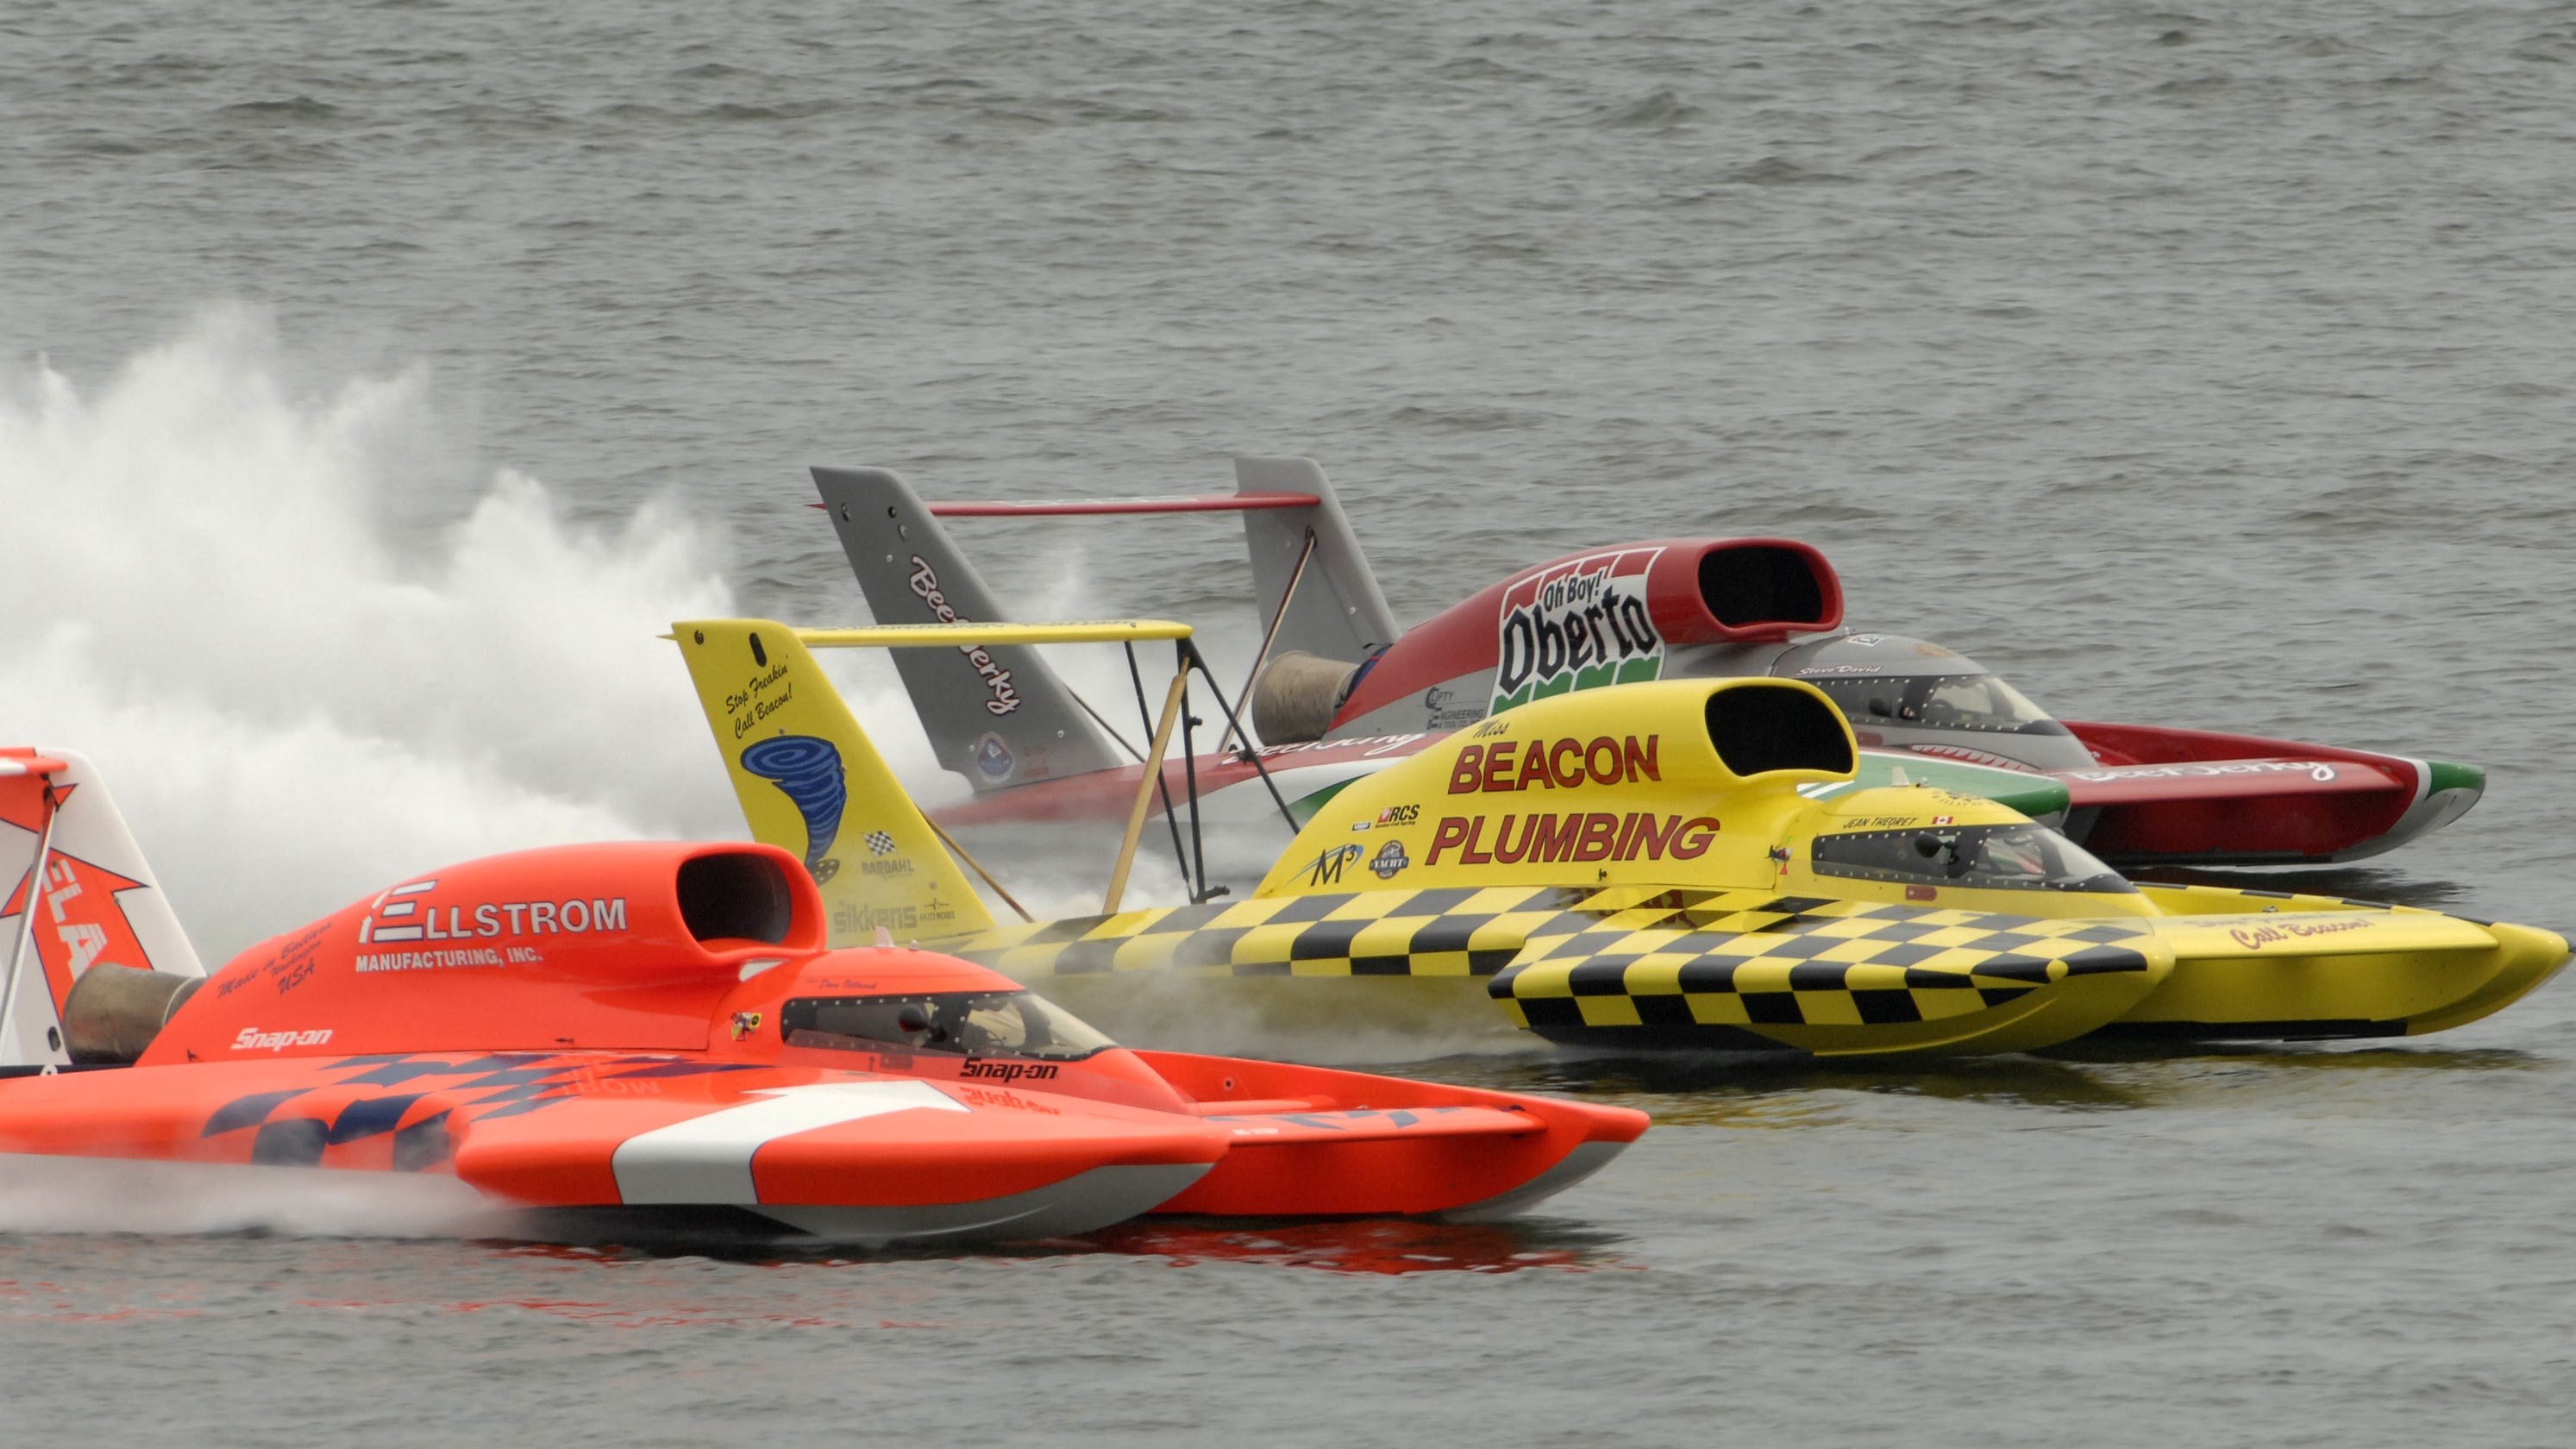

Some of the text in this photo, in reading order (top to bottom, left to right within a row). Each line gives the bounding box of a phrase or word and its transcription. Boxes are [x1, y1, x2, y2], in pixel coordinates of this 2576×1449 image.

[910, 555, 972, 624] Bee
[1543, 569, 1603, 612] Oh Boy!
[1499, 584, 1658, 695] Oberto
[1834, 665, 1882, 674] David
[726, 690, 749, 714] Stop
[735, 682, 793, 739] Call Beacon!
[1473, 718, 1509, 738] Miss
[1447, 734, 1663, 795] BEACON
[1388, 804, 1420, 822] RCS
[1843, 819, 1871, 829] JEAN
[1424, 812, 1721, 866] PLUMBING
[358, 878, 628, 944] ELLSTROM
[355, 946, 543, 973] MANUFACTURING, INC.
[230, 1027, 334, 1052] Snap-on
[959, 1057, 1060, 1083] Snap-on
